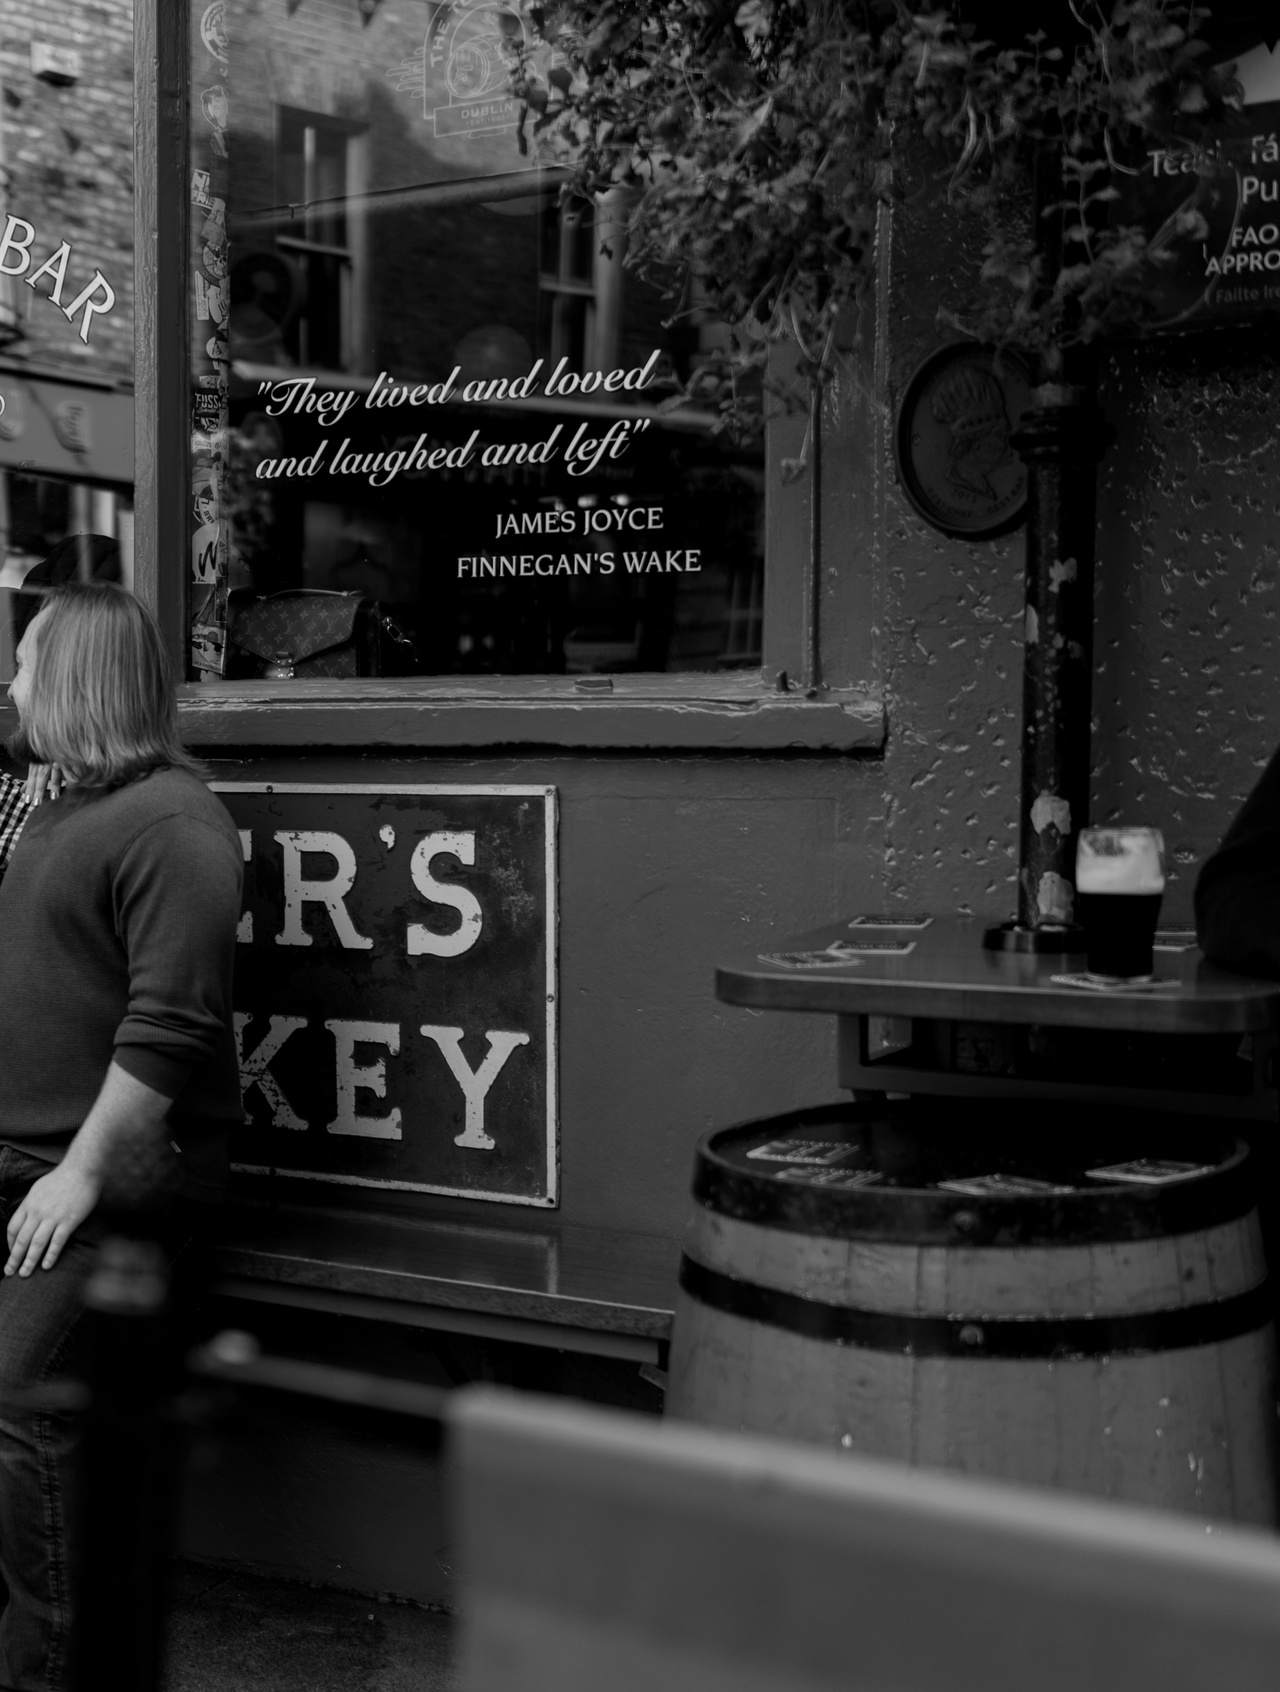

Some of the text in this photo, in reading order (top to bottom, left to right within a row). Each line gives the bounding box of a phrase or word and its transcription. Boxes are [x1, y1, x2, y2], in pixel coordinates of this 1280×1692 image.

[461, 102, 513, 119] DUBLIN
[255, 349, 662, 427] "They lived and loved
[255, 435, 325, 479] and
[329, 429, 480, 488] laughed
[481, 424, 564, 467] and
[564, 418, 651, 476] left"
[495, 506, 664, 539] JAMES JOYCE
[457, 549, 702, 579] FINNEGAN'S WAKE
